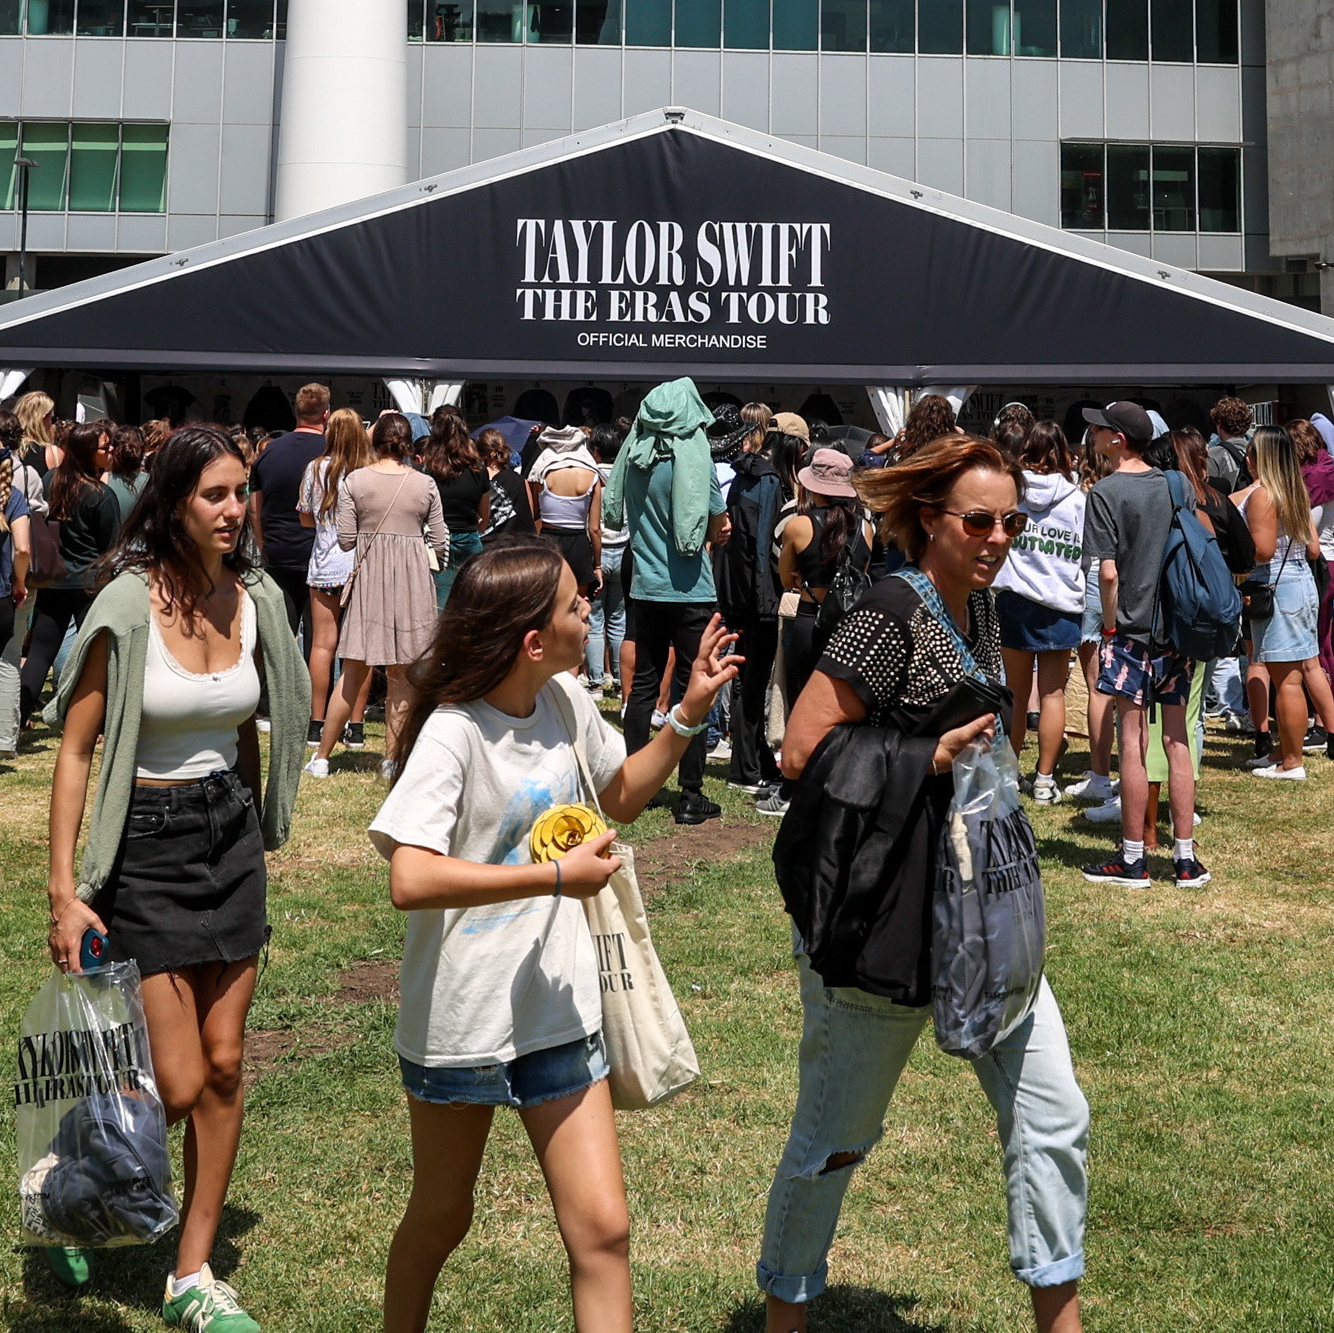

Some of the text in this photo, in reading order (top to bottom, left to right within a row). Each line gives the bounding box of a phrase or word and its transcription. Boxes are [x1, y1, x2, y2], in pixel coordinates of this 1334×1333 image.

[516, 219, 831, 287] TAYLOR SWIFT
[516, 288, 831, 325] THE ERAS TOUR
[577, 333, 767, 349] OFFICIAL MERCHANDISE
[969, 393, 1004, 410] SWIFT
[1041, 526, 1071, 541] LOVE
[1012, 535, 1082, 561] OUTDATED
